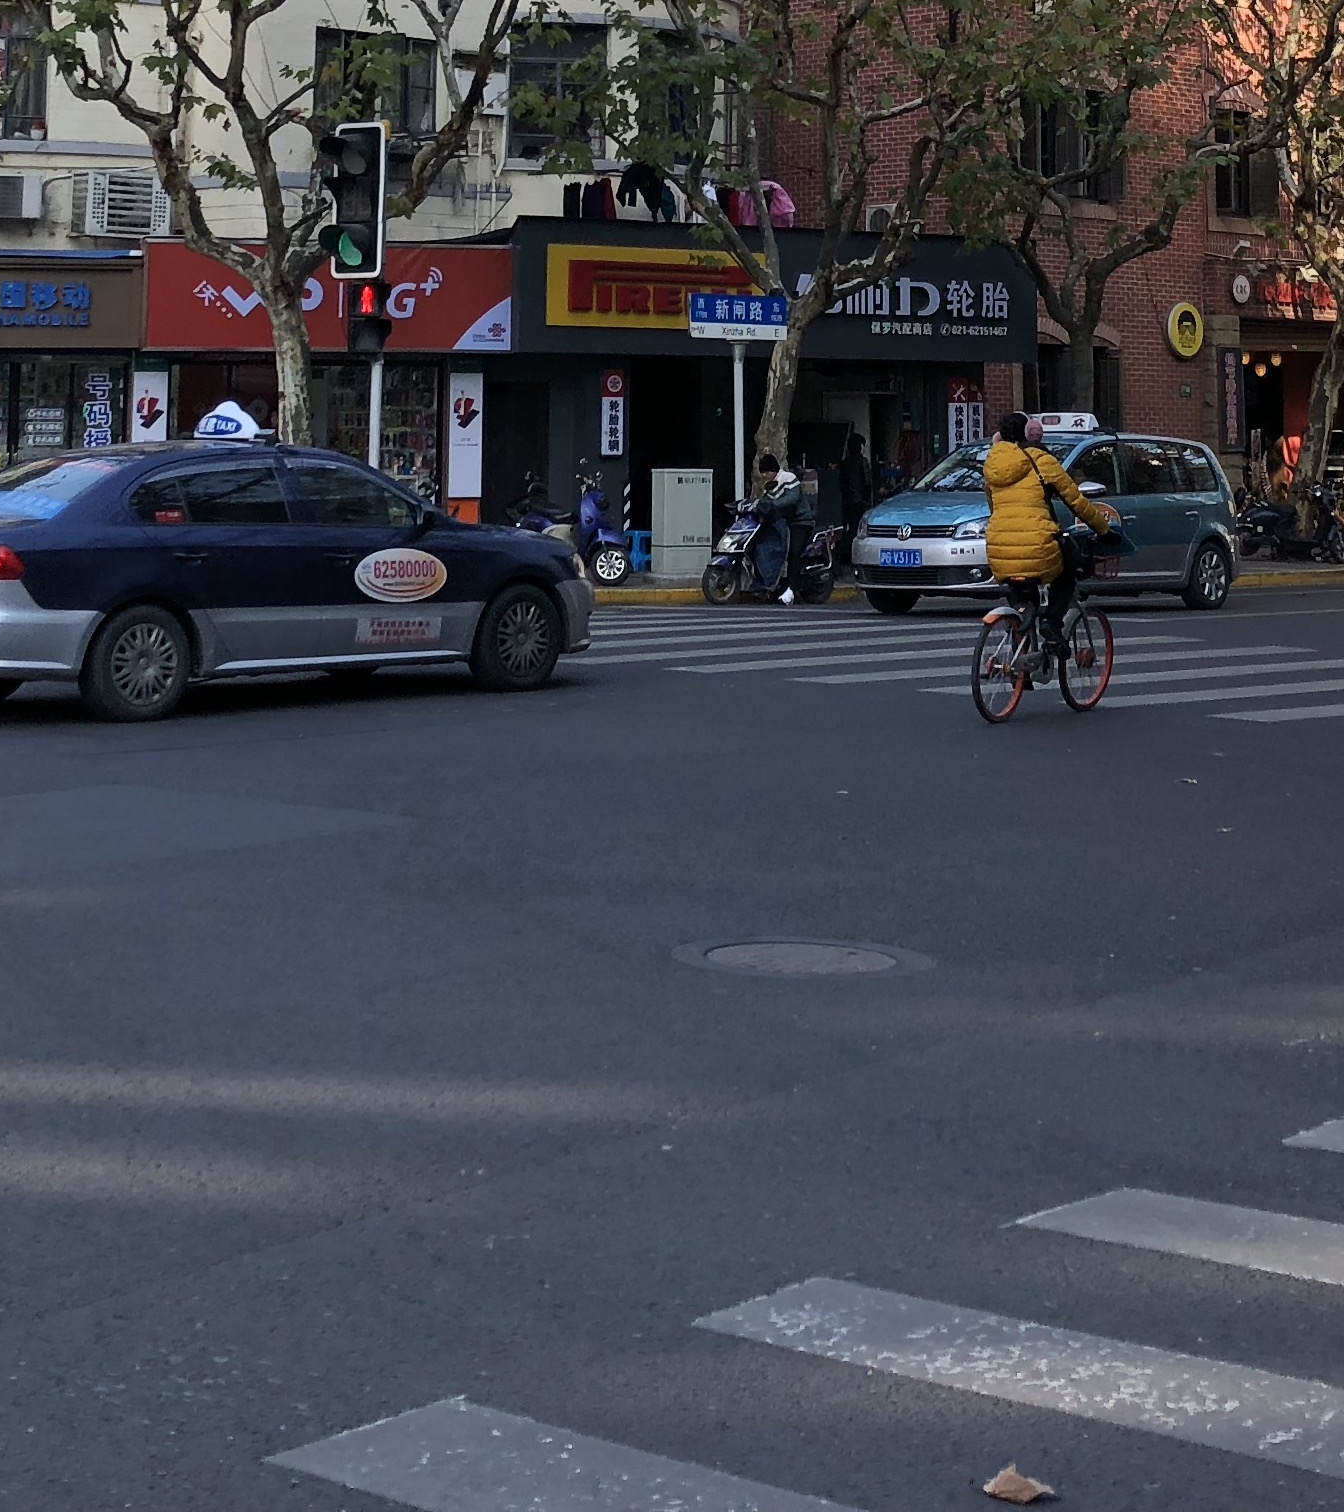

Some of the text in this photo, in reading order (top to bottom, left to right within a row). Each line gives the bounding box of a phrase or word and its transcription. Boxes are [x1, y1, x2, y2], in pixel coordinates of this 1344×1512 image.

[715, 299, 763, 322] 新闸路
[373, 560, 437, 579] 62580000
